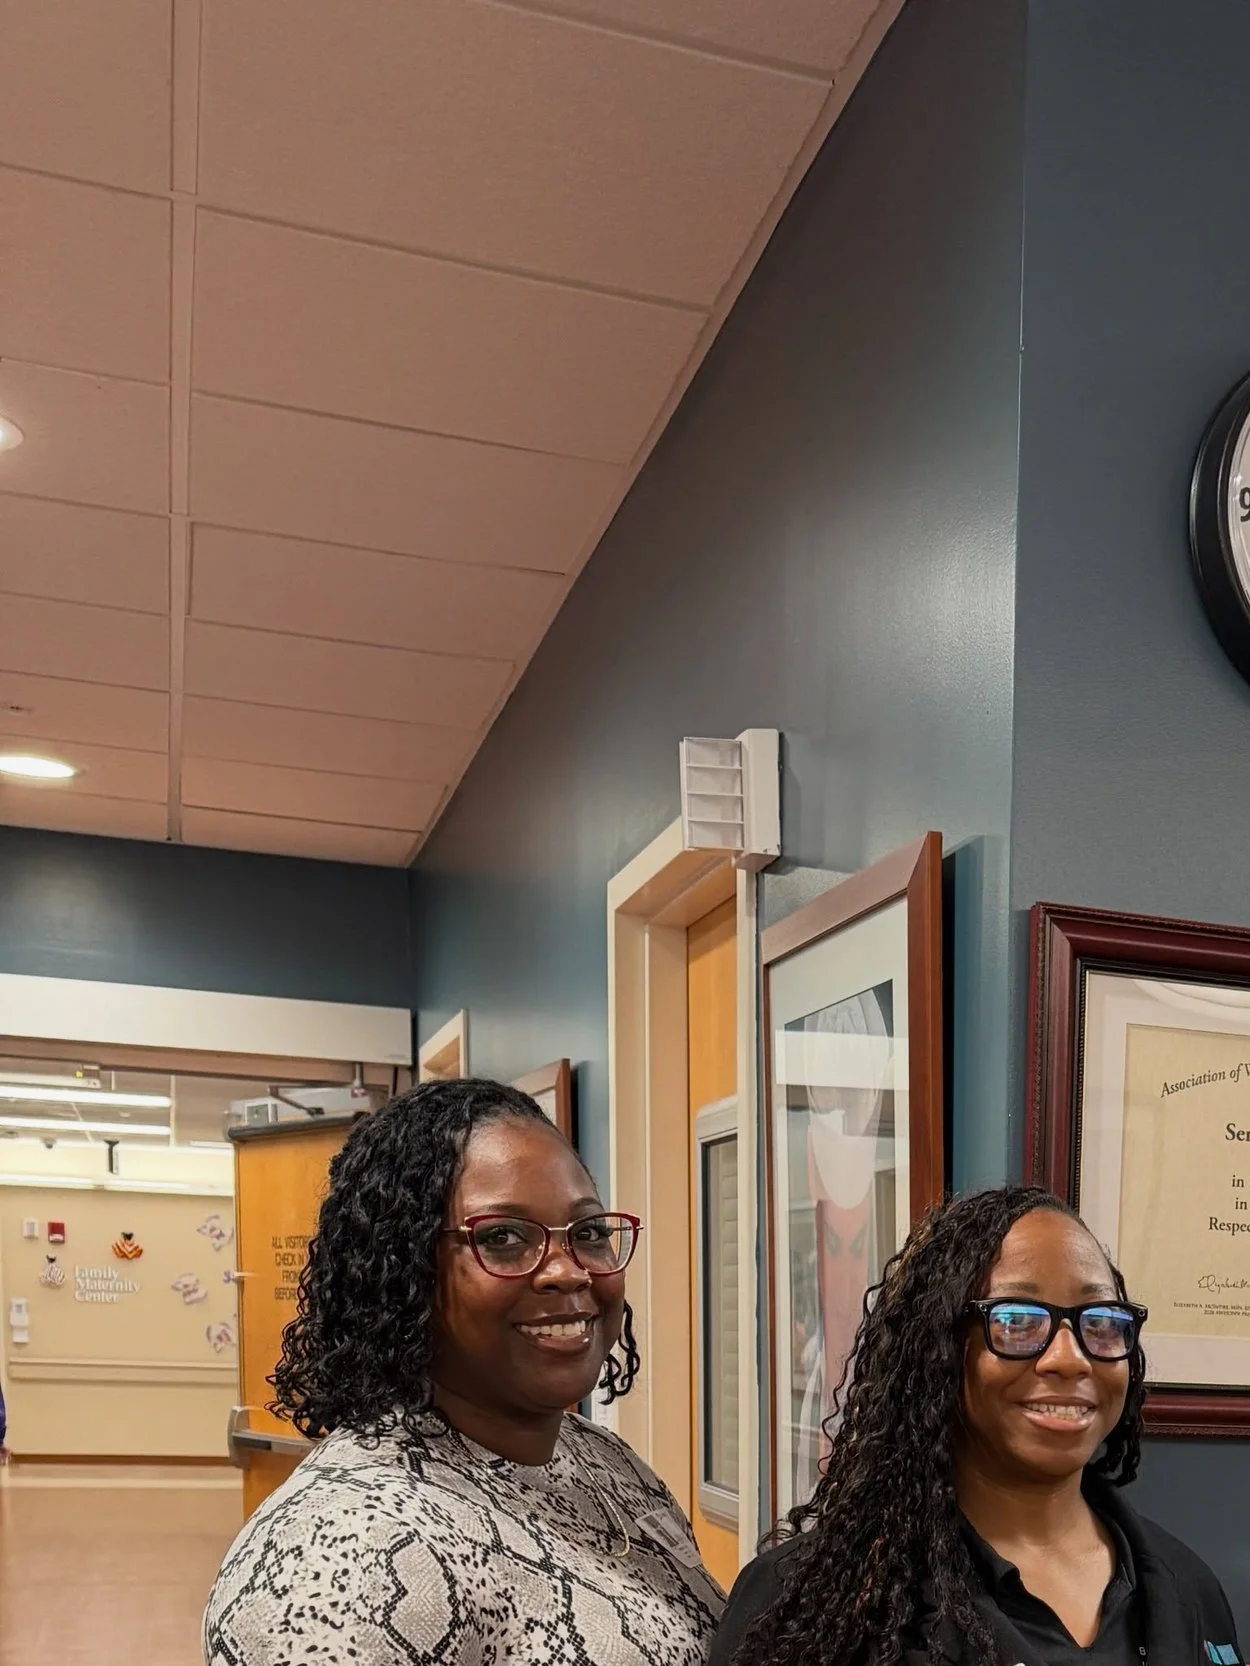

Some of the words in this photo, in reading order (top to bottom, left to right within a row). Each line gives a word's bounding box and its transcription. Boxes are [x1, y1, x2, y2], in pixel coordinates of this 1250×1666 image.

[1160, 1070, 1226, 1098] Association
[1230, 1063, 1243, 1082] of
[1232, 1174, 1244, 1188] in
[1235, 1197, 1248, 1210] in
